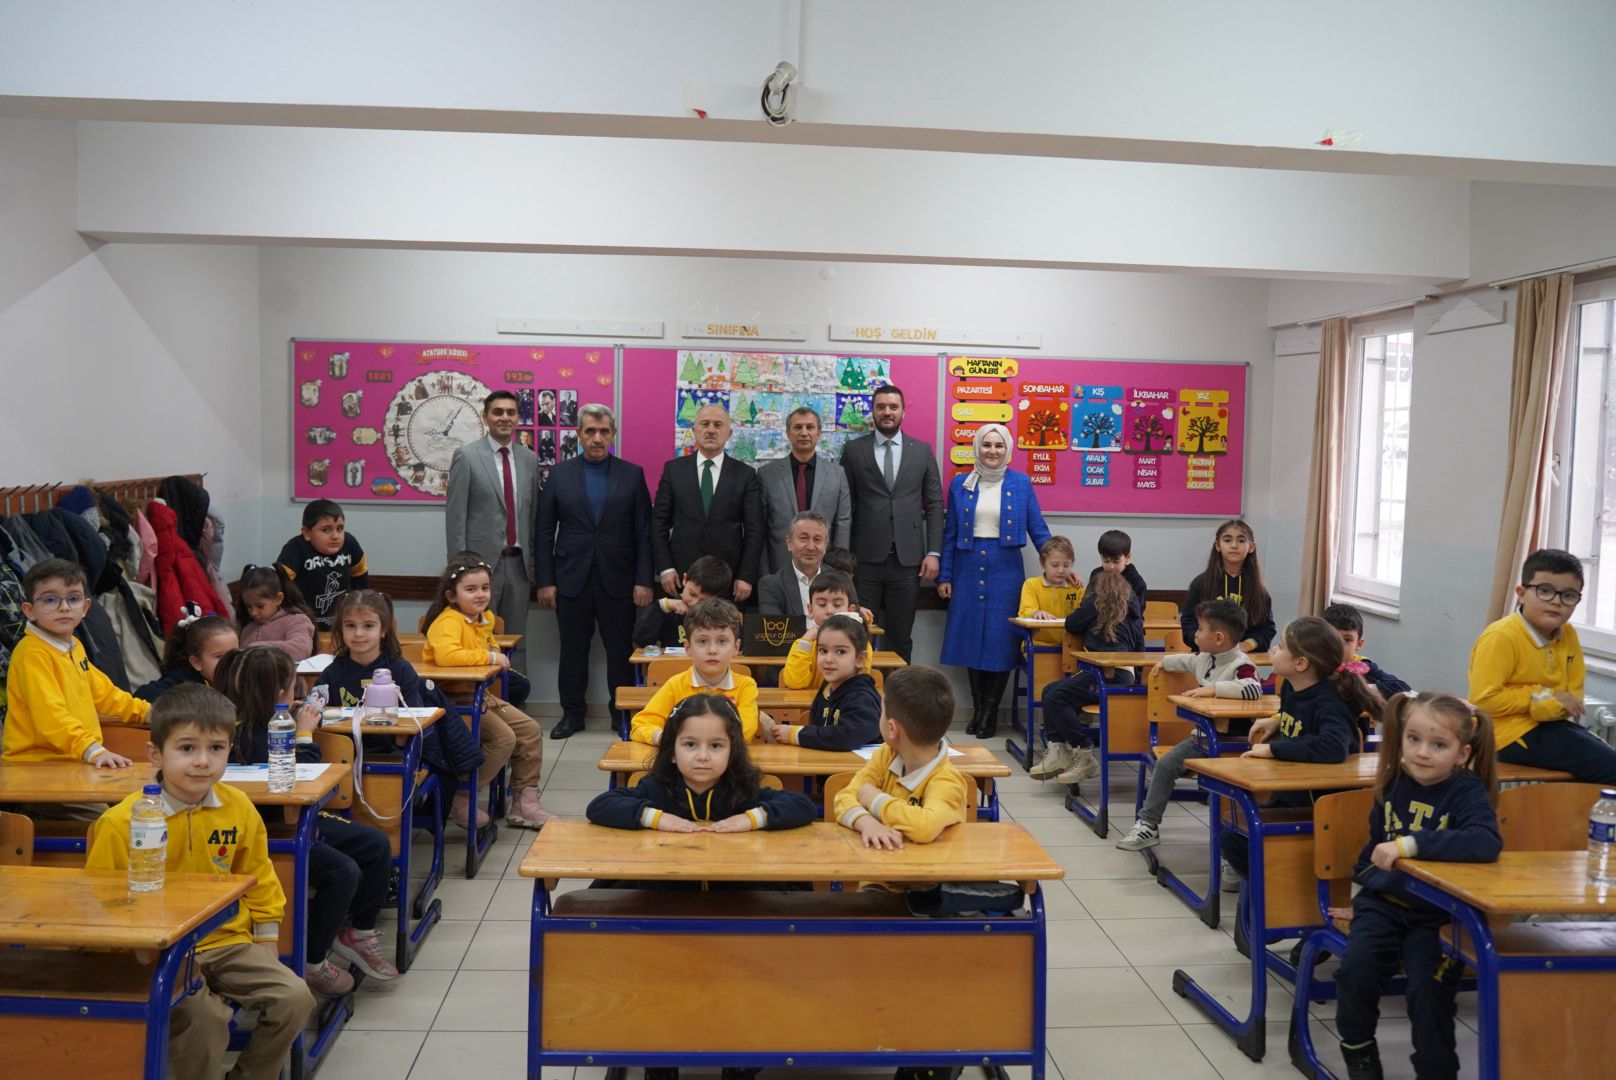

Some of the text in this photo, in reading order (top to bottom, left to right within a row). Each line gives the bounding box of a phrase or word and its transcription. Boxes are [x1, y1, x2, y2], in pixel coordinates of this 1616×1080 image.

[890, 326, 937, 341] GELDİN
[956, 386, 993, 395] PAZARTESİ
[1022, 384, 1065, 394] SONBAHAR
[1133, 388, 1169, 400] İLKBAHAR
[1196, 391, 1210, 400] YAZ
[1138, 457, 1157, 465] MART
[1086, 466, 1105, 474] OCAK
[207, 826, 238, 845] ATİ
